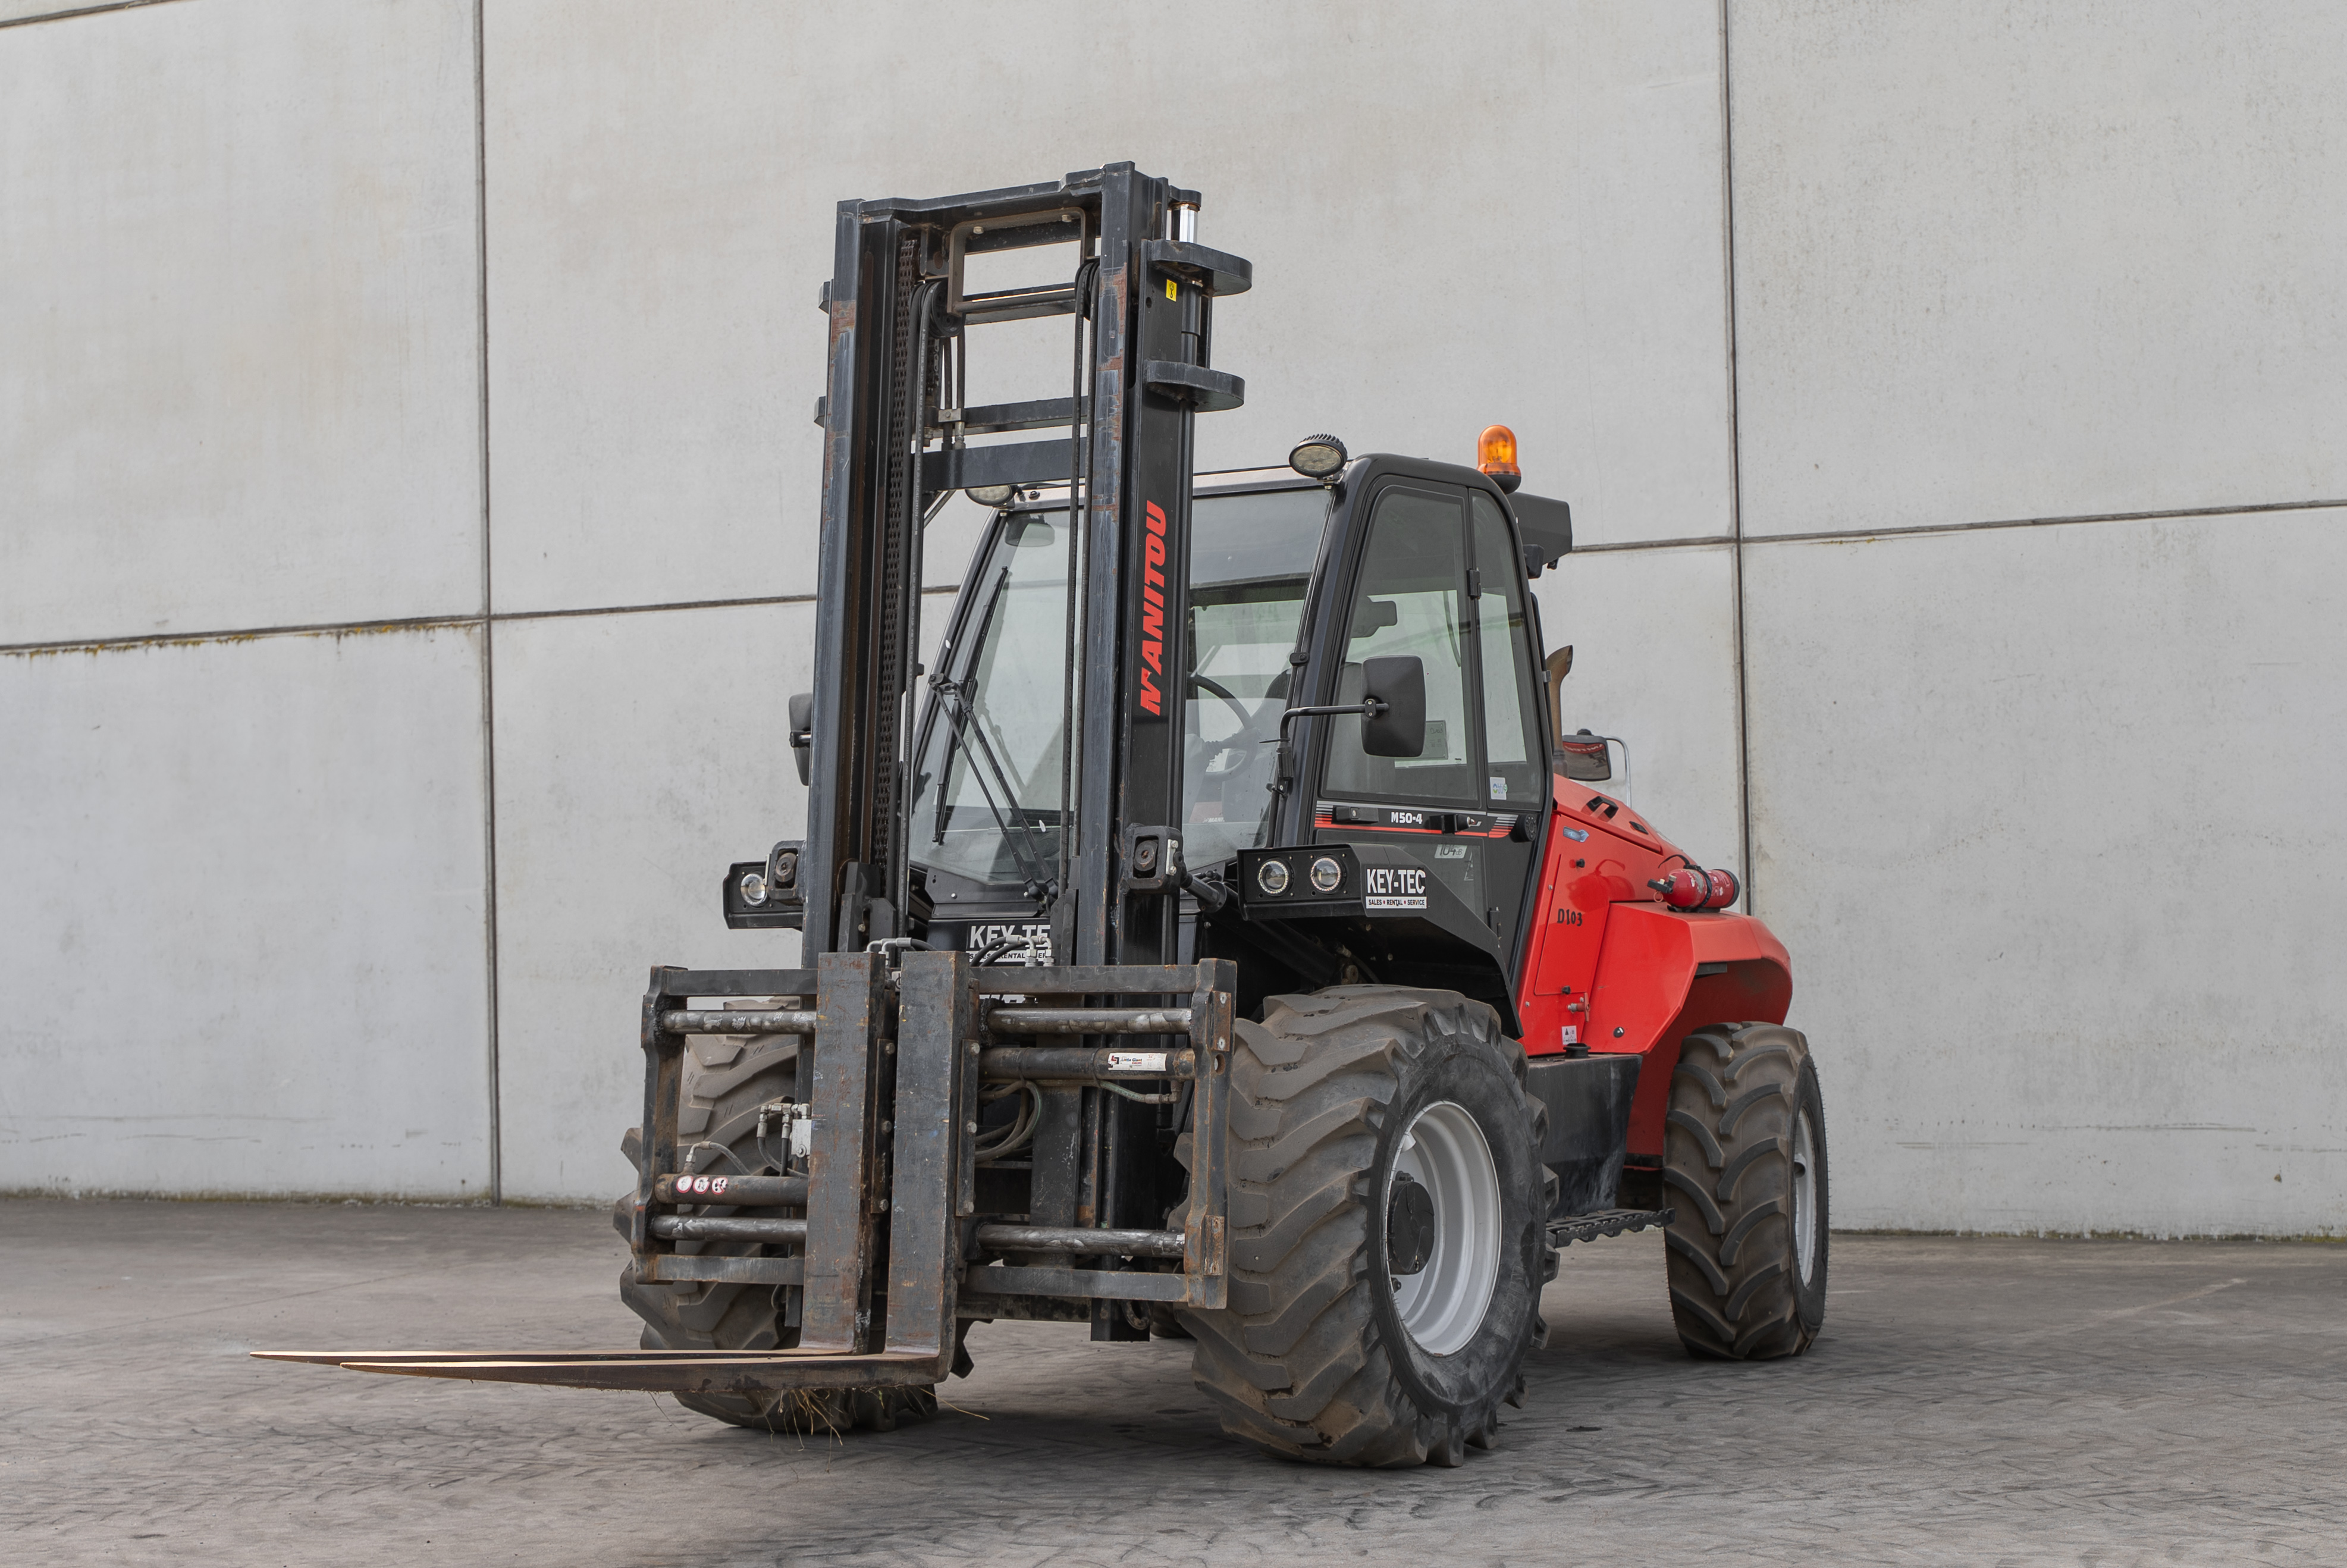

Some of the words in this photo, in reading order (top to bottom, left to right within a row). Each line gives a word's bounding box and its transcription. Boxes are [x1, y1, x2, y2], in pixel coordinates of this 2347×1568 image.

[1140, 500, 1166, 716] MANITOU
[1391, 812, 1423, 824] M50-4
[1367, 869, 1426, 894] KEY-TEC
[1557, 908, 1583, 927] D103
[969, 925, 1050, 948] KEYTE
